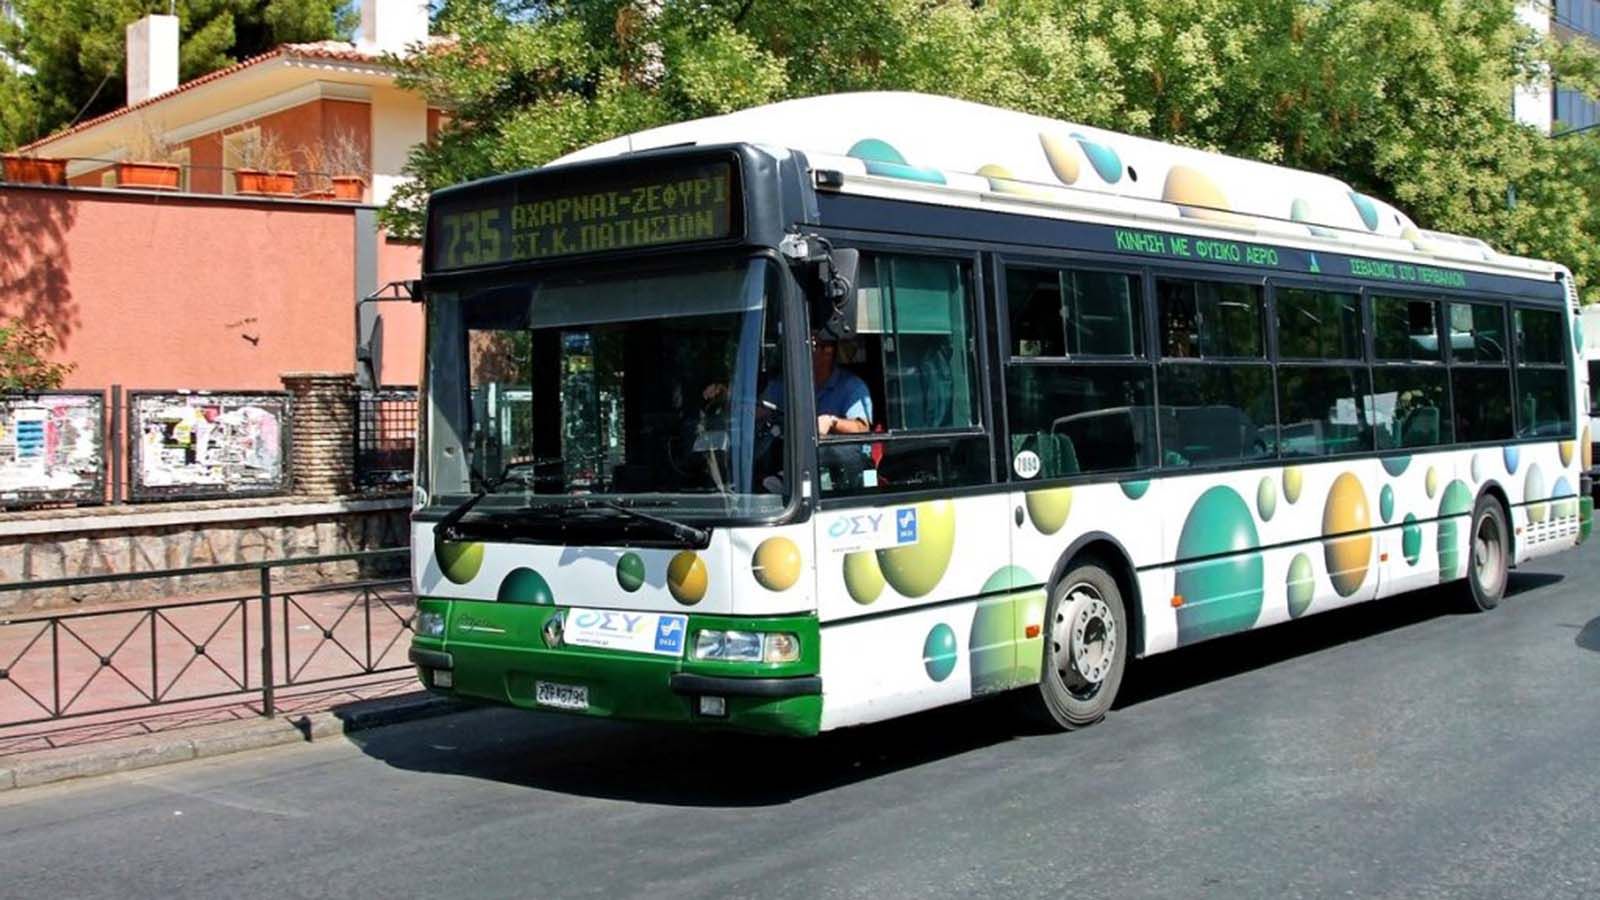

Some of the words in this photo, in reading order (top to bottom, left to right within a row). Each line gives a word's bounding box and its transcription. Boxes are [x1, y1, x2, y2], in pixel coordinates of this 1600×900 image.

[443, 208, 501, 265] 735
[1115, 229, 1165, 254] ΚΙΝΗΣΗ
[1170, 237, 1190, 257] ΜΕ
[1196, 240, 1240, 262] ΦΥΣΙΚΟ
[1246, 247, 1279, 266] ΑΕΡΙΟ
